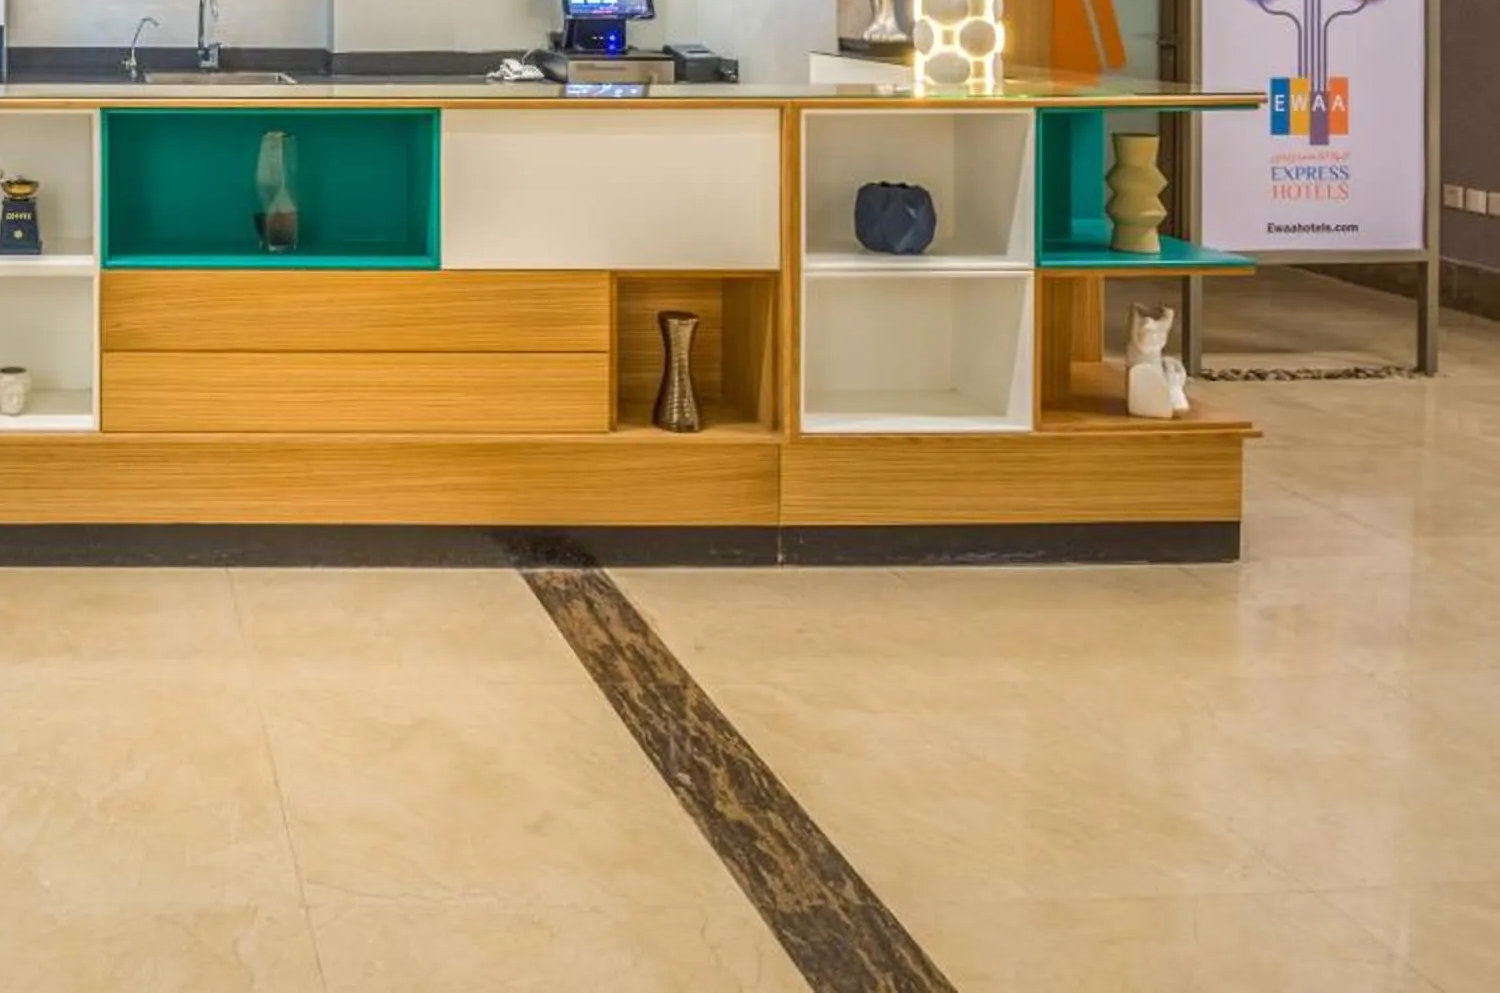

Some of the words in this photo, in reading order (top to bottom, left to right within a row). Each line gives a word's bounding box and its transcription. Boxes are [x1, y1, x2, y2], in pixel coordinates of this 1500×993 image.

[1274, 94, 1346, 112] EWAA
[1270, 164, 1351, 182] EXPRESS
[1272, 183, 1350, 201] HOTELS
[1266, 222, 1359, 235] Ewaahotels.com
